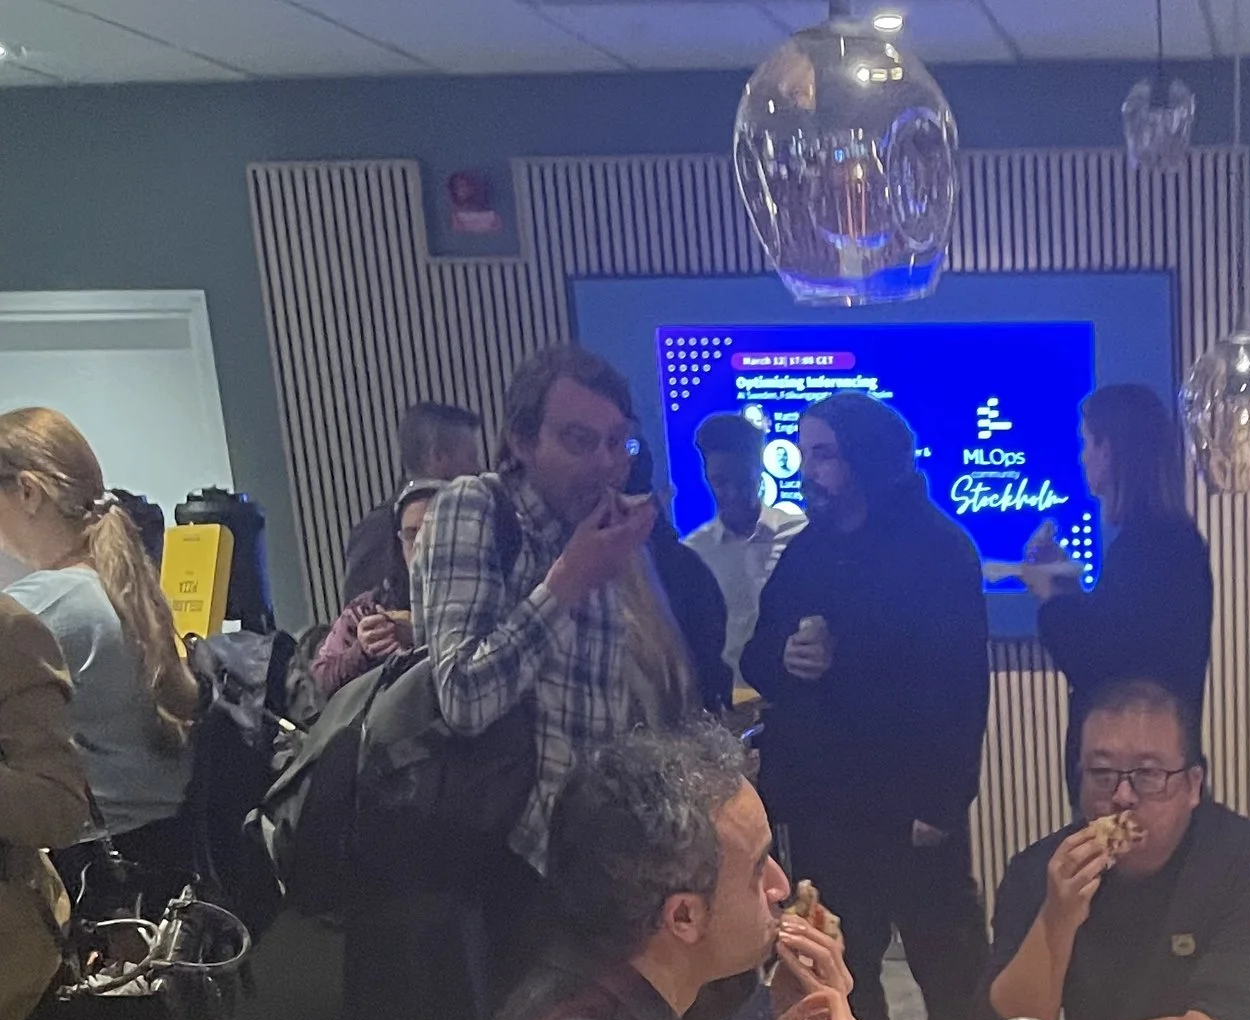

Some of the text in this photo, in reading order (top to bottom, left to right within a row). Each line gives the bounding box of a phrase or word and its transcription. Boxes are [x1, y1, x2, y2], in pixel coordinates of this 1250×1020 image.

[735, 375, 805, 391] Optimizing
[963, 448, 1026, 467] MLOps
[950, 474, 1069, 515] Stockholm
